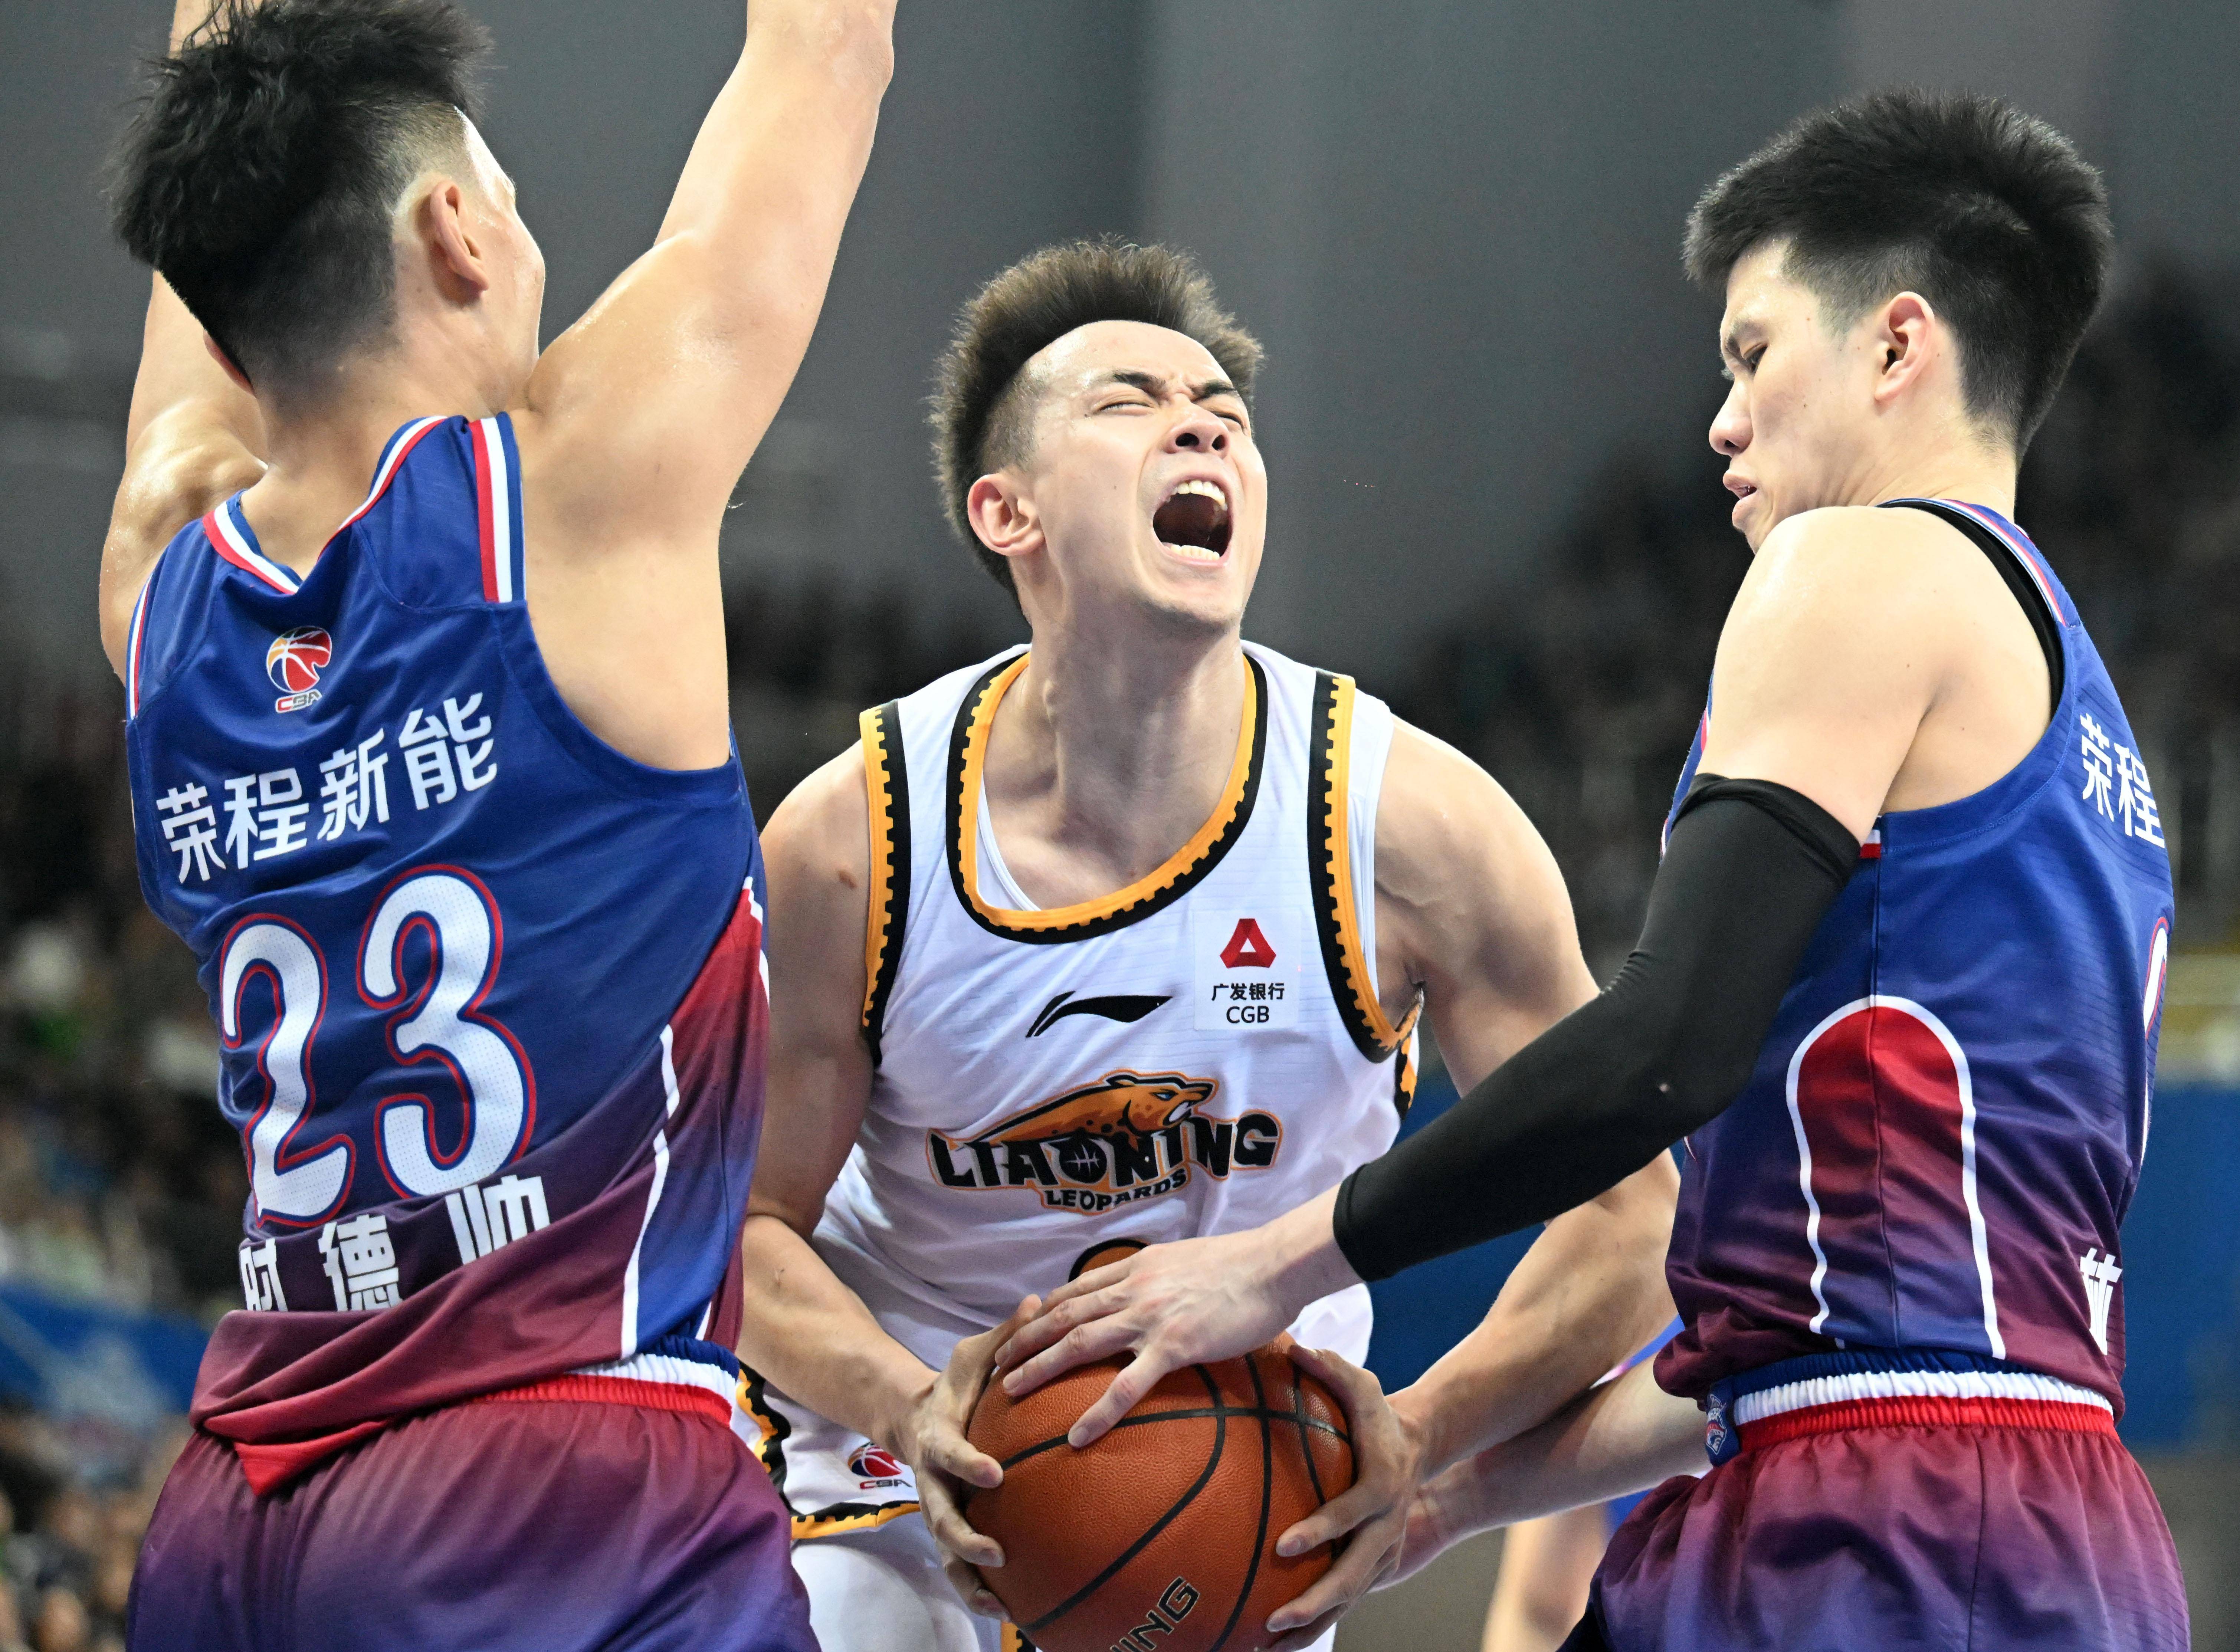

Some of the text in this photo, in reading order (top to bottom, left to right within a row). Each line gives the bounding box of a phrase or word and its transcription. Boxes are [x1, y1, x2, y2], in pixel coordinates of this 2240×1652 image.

[276, 690, 321, 712] CBA
[157, 692, 498, 883] 荣程新能
[2080, 713, 2165, 848] 荣程
[1211, 982, 1285, 1001] 广发银行
[1226, 1005, 1270, 1024] CGB
[222, 864, 536, 1226] 23
[928, 1111, 1281, 1188] LIAONING
[1046, 1168, 1187, 1211] LEOPARDS
[859, 1479, 912, 1490] CBA
